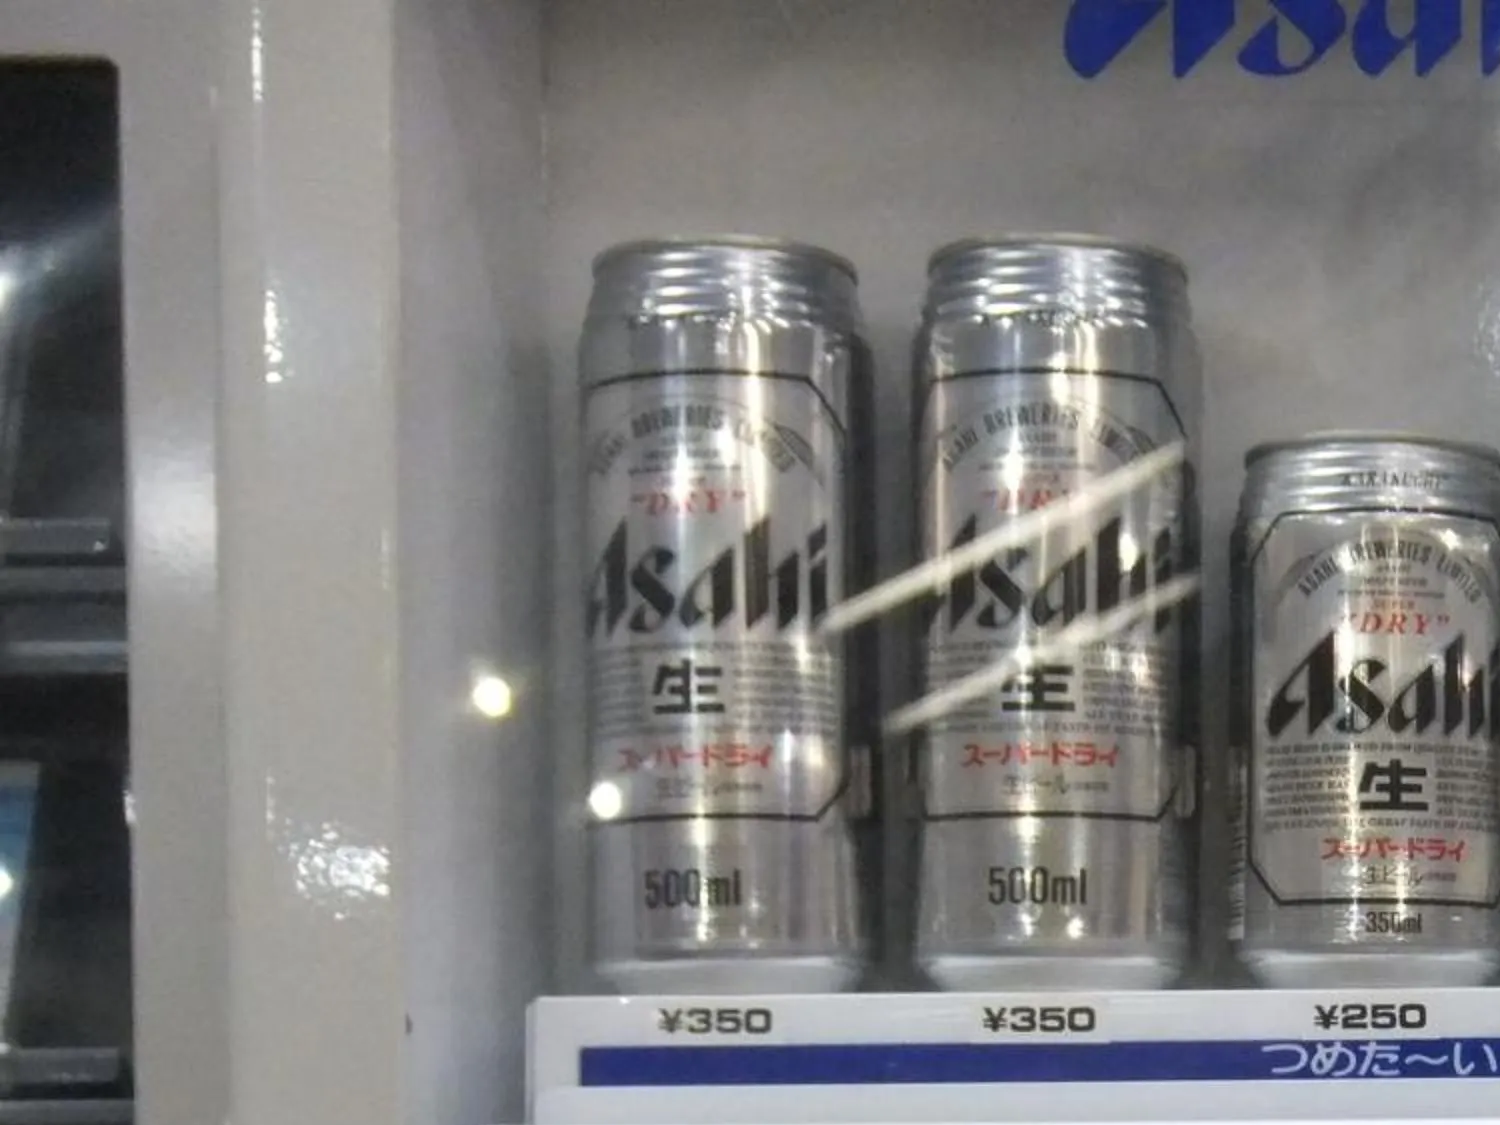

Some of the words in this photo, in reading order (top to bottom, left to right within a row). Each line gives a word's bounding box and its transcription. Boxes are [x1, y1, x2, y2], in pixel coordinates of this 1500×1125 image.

[585, 514, 829, 640] Asahi
[653, 658, 725, 716] 生
[1358, 758, 1429, 811] 生
[1321, 836, 1466, 862] スーパードライ
[988, 866, 1088, 905] 500ml
[659, 1008, 772, 1033] ¥350
[983, 1007, 1095, 1032] ¥350
[1314, 1004, 1427, 1029] ¥250
